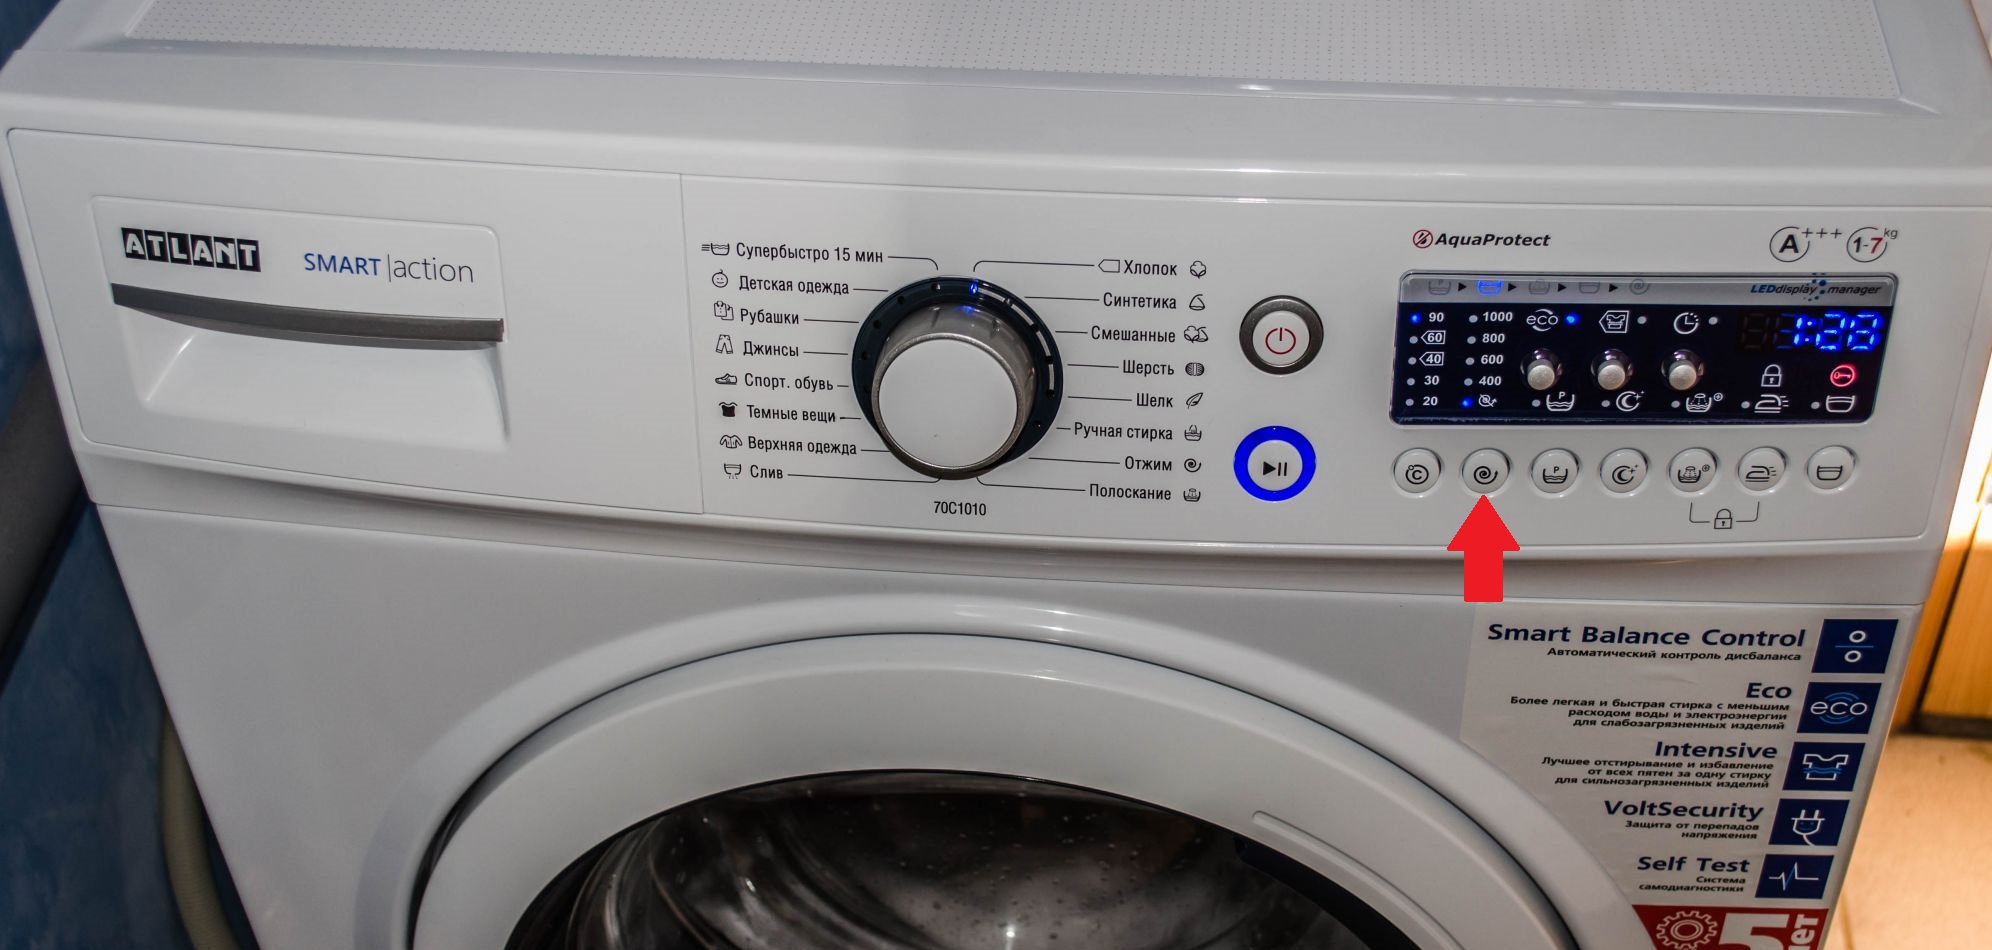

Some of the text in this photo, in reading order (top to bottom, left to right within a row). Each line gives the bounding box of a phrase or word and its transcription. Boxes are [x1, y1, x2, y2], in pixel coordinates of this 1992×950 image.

[1435, 233, 1551, 248] AquaProtect
[1883, 228, 1898, 240] kg
[121, 227, 261, 272] ATLANT
[736, 242, 883, 263] Супербыстро 15 мин
[303, 252, 381, 277] SMART
[1123, 260, 1177, 276] Хлопок
[739, 275, 849, 295] Детская одежда
[1827, 285, 1882, 296] manager
[1103, 292, 1177, 310] Синтетика
[740, 308, 800, 326] Рубашки
[1428, 312, 1444, 322] 90
[1482, 312, 1513, 322] 1000
[1526, 314, 1559, 326] eco
[1091, 325, 1176, 343] Смешанные
[1427, 332, 1443, 343] 60
[1482, 333, 1505, 344] 800
[743, 341, 799, 357] Джинсы
[1426, 354, 1441, 364] 40
[1480, 354, 1504, 365] 600
[1122, 360, 1175, 377] Шерсть
[744, 372, 834, 392] Спорт. обувь
[1424, 375, 1440, 386] 30
[1478, 375, 1502, 386] 400
[1136, 393, 1174, 408] Шелк
[1423, 397, 1438, 406] 20
[746, 404, 836, 423] Темные вещи
[1074, 422, 1173, 442] Ручная стирка
[748, 436, 857, 455] Верхняя одежда
[1124, 456, 1172, 471] Отжим
[750, 464, 783, 479] Слив
[1089, 484, 1171, 501] Полоскание
[1488, 623, 1806, 647] Smart Balance Control
[1547, 647, 1801, 661] Автоматический контроль дисбаланса
[1746, 682, 1792, 699] Eco
[1510, 696, 1549, 704] Более
[1552, 699, 1594, 707] легкая
[1612, 698, 1665, 709] быстрая
[1670, 702, 1712, 710] стирка
[1727, 703, 1789, 711] меньшим
[1810, 700, 1868, 716] eco
[1568, 709, 1630, 717] расходом
[1635, 710, 1669, 719] воды
[1686, 713, 1787, 721] электроэнергии
[1573, 719, 1785, 730] для слабозагрязненных изделий
[1655, 741, 1777, 758] Intensive
[1541, 756, 1590, 766] Лучшее
[1594, 759, 1683, 769] отстирывание
[1700, 761, 1774, 770] избавление
[1582, 777, 1712, 788] сильнозагрязненных
[1730, 772, 1771, 780] стирку
[1604, 800, 1764, 822] VoltSecurity
[1625, 820, 1672, 829] Защита
[1681, 832, 1758, 840] напряжения
[1637, 856, 1750, 873] Self Test
[1696, 876, 1746, 884] Система
[1639, 884, 1744, 892] самодиагностики
